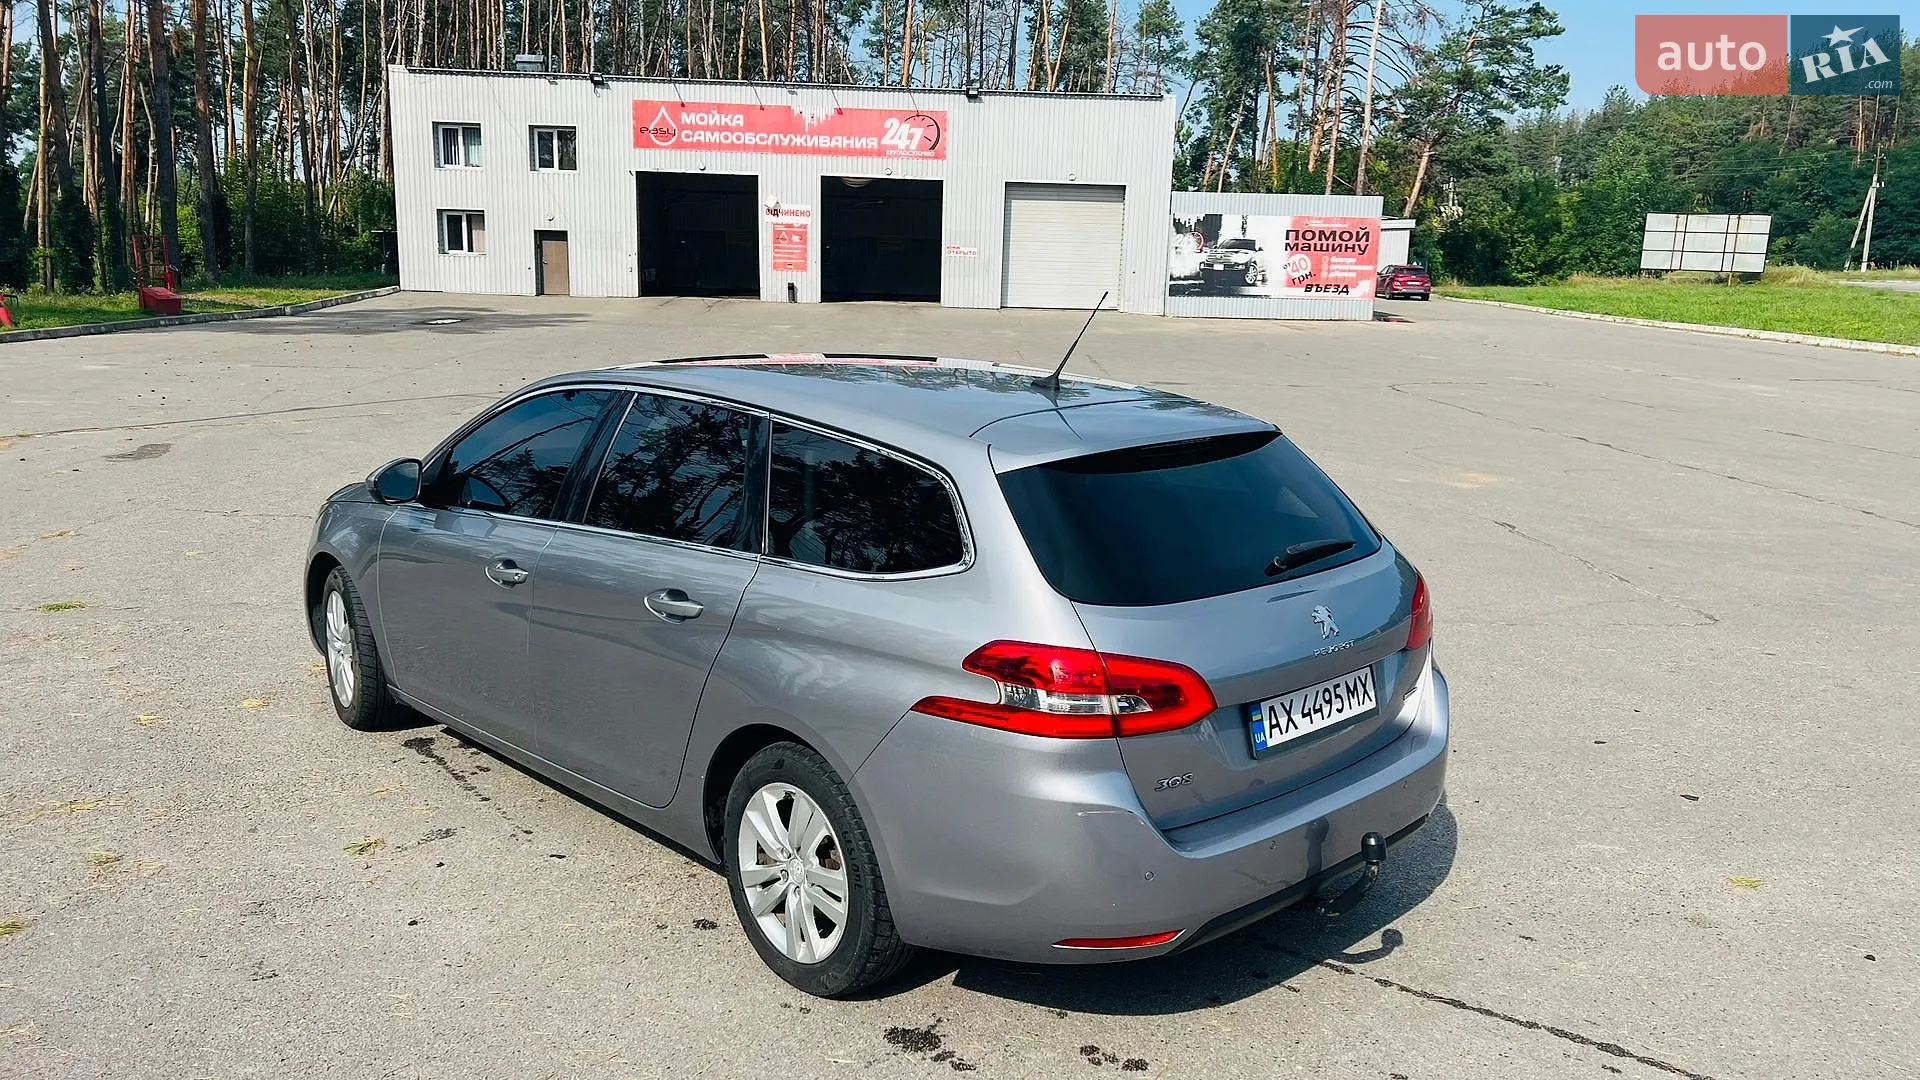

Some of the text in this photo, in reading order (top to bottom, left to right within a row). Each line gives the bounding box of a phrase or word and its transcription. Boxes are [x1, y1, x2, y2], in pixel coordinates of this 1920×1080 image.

[681, 109, 744, 127] МОЙКА
[640, 126, 676, 137] easy
[681, 129, 878, 149] САМООБСЛУЖИВАНИЯ
[1284, 242, 1370, 255] машину
[1291, 257, 1309, 273] 40
[1291, 271, 1317, 286] грн.
[1304, 283, 1350, 296] ВЪЕЗД
[1268, 672, 1373, 739] AX 4495 MX
[1254, 732, 1266, 744] UA
[1153, 772, 1193, 792] 308
